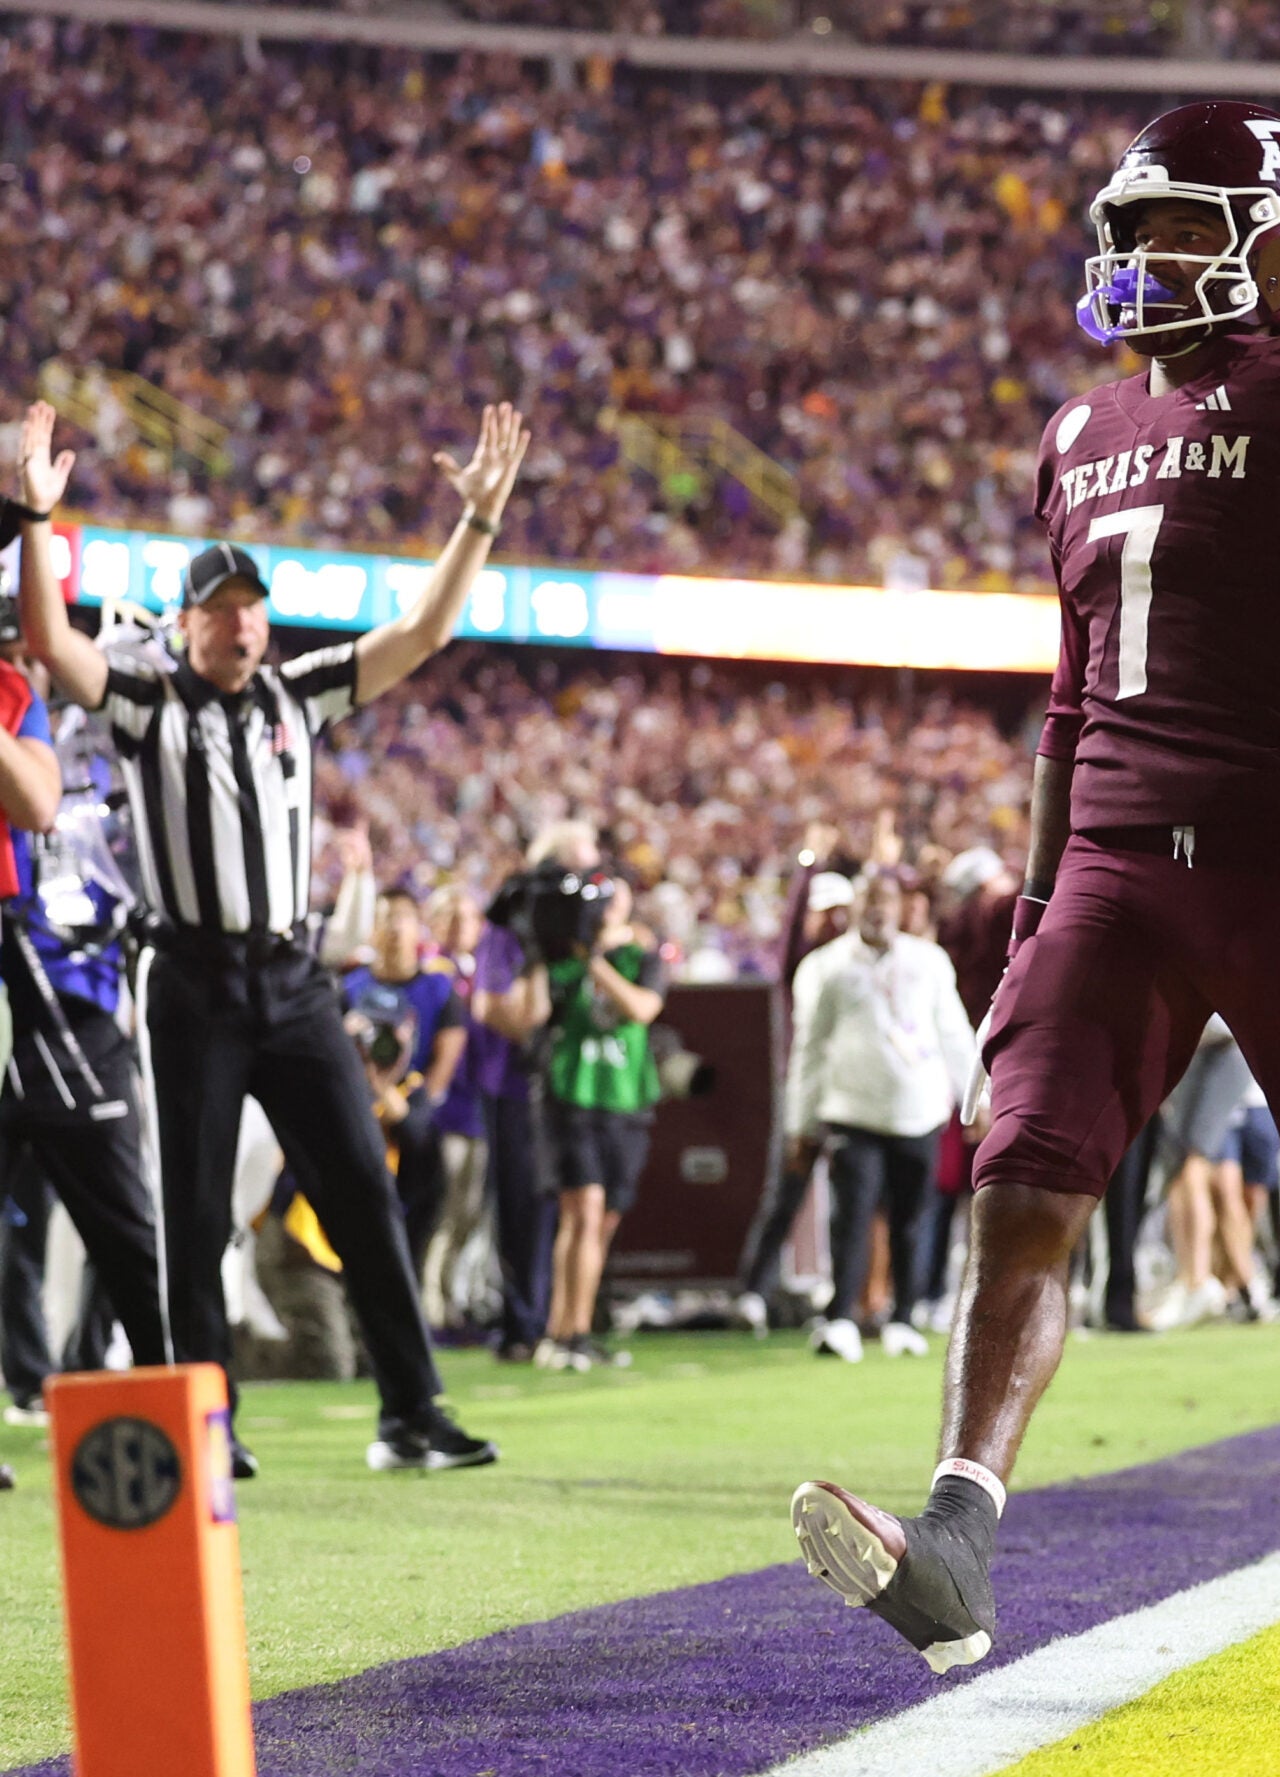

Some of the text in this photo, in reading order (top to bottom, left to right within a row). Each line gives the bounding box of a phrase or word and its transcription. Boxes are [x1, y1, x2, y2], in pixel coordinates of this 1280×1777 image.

[1059, 436, 1251, 516] TEXAS A&M
[1086, 504, 1164, 701] 7
[78, 1421, 176, 1521] SEC
